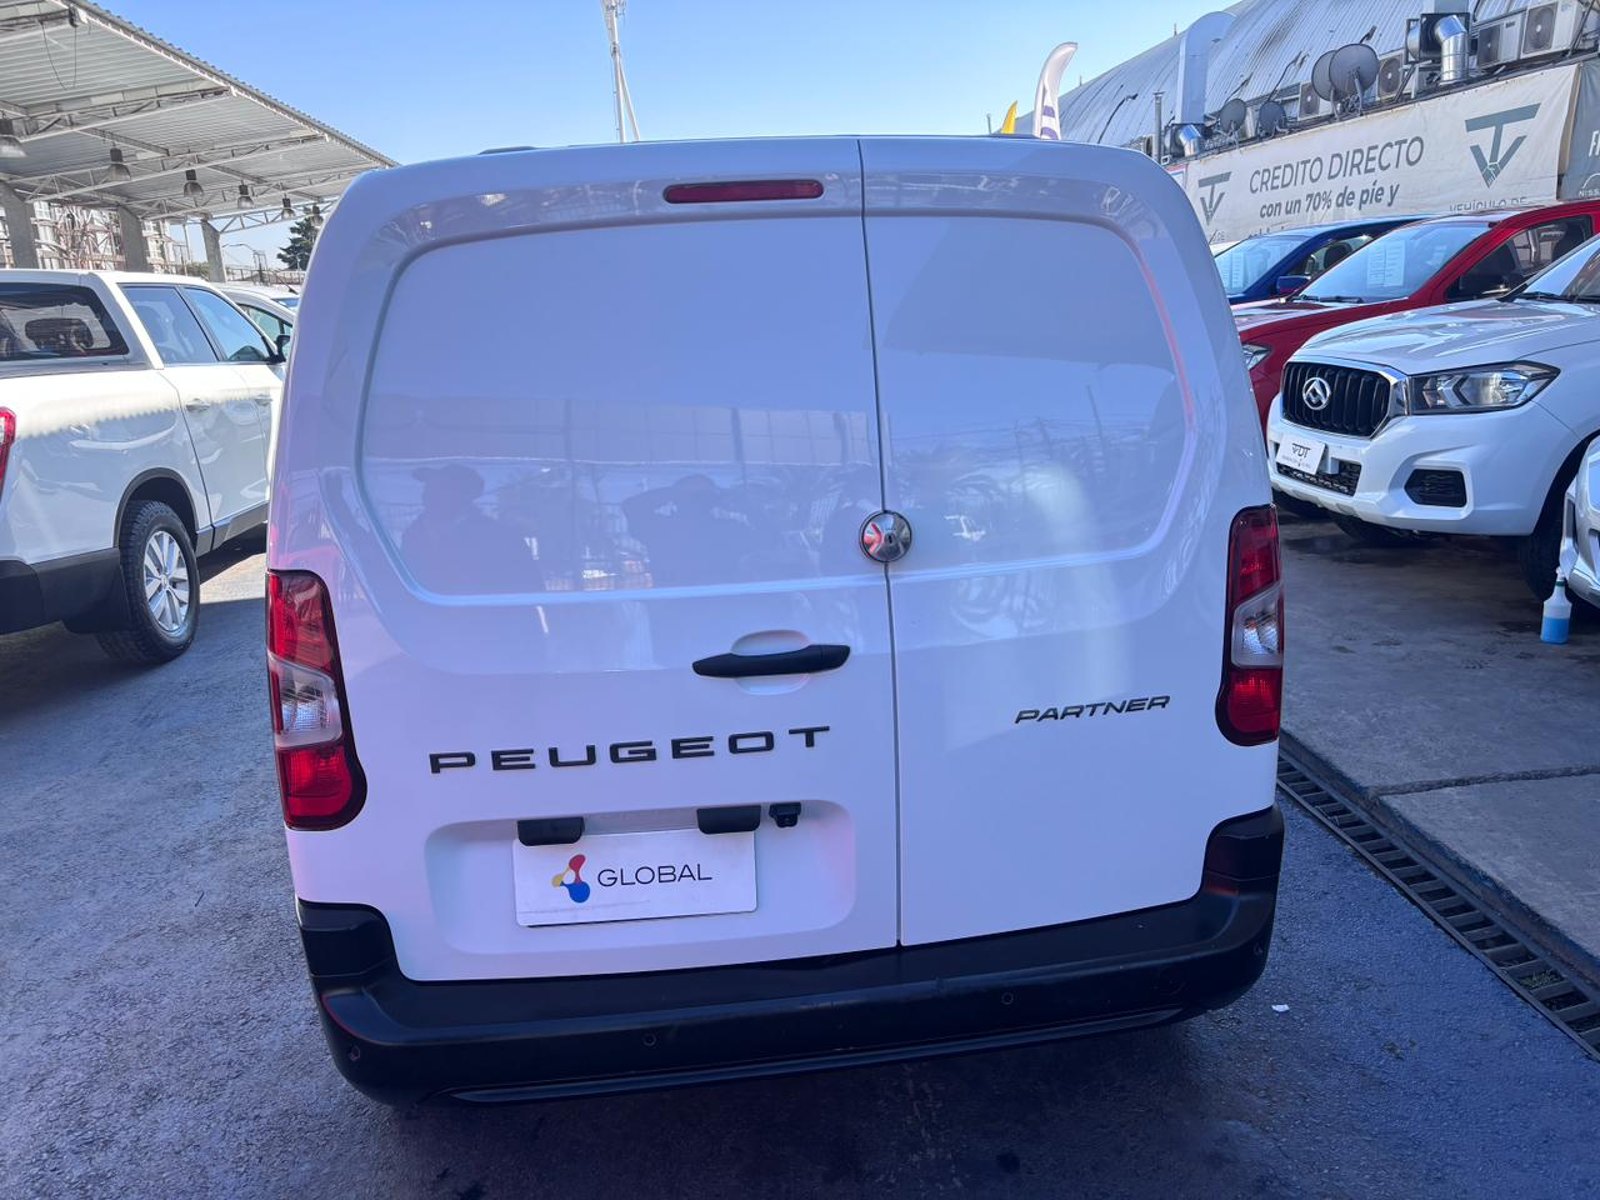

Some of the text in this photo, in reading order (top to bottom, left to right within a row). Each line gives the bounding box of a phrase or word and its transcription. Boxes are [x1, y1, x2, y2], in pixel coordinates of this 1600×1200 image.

[1249, 135, 1424, 194] CREDITO DIRECTO
[1259, 201, 1282, 219] con
[1285, 199, 1301, 215] un
[1305, 189, 1332, 213] 70%
[1335, 185, 1355, 208] de
[1387, 183, 1400, 207] y
[1015, 695, 1171, 724] PARTNER
[429, 725, 831, 774] PEUGEOT
[597, 863, 713, 888] GLOBAL
